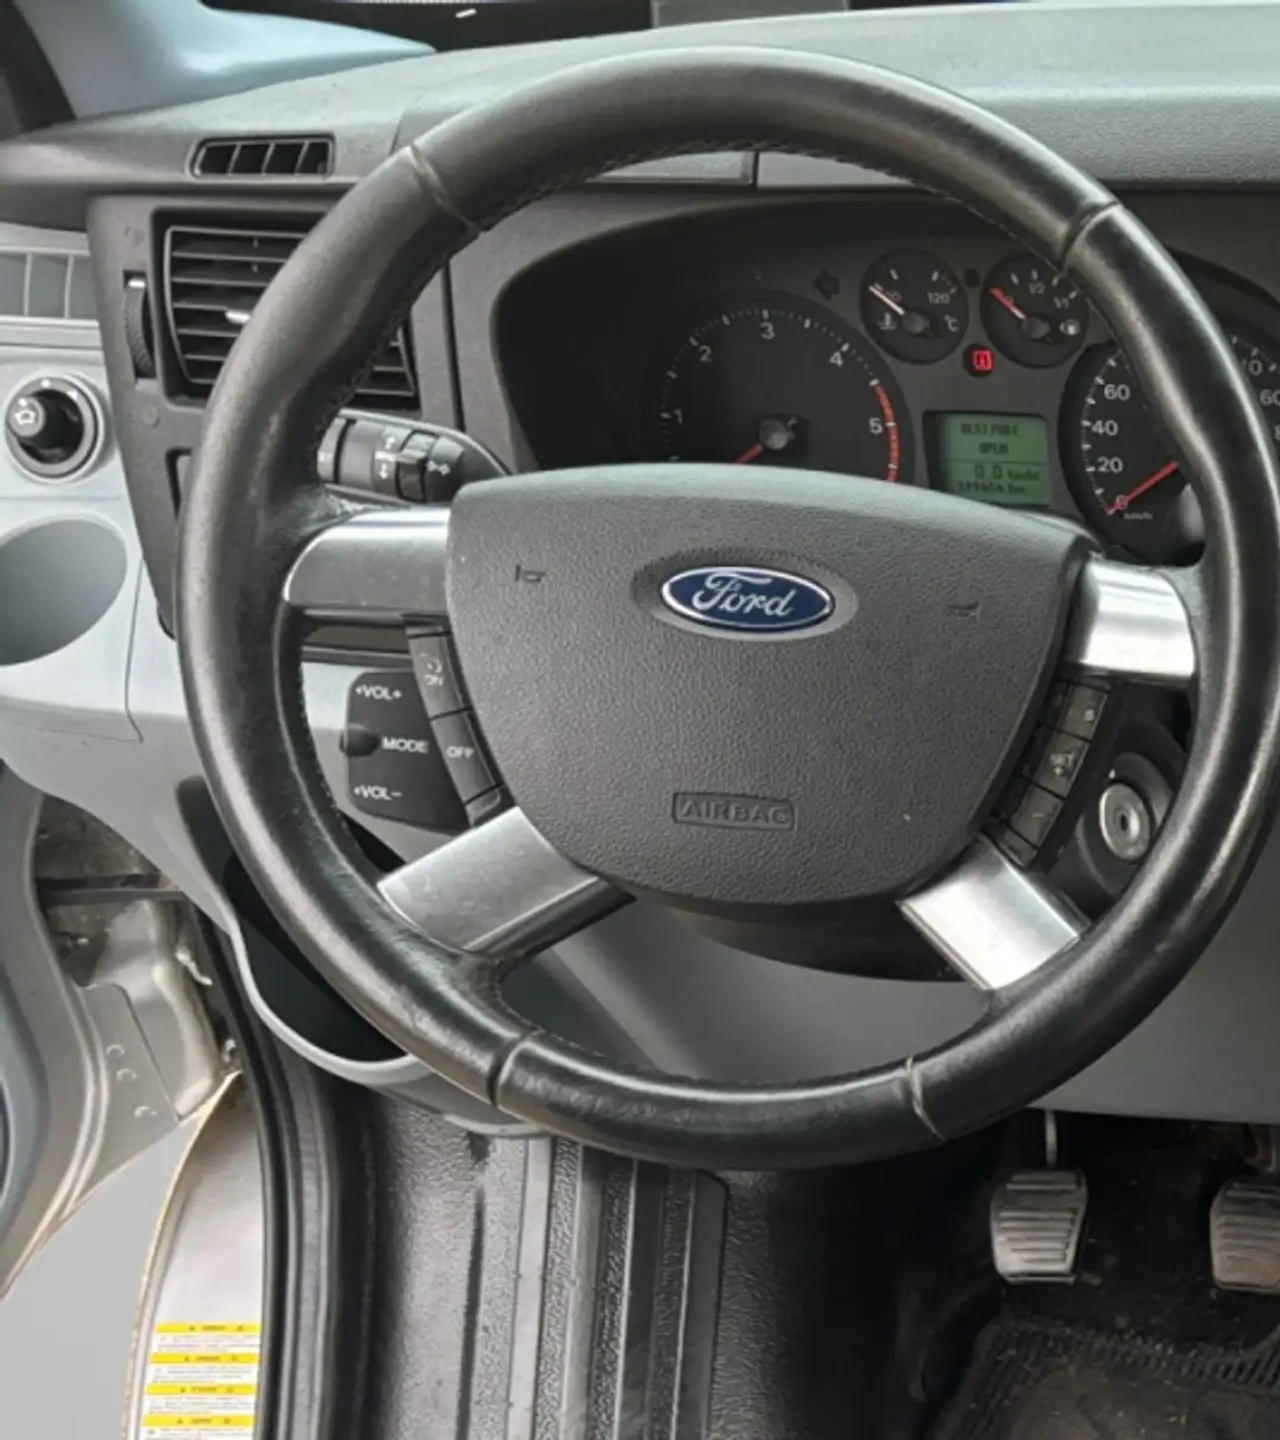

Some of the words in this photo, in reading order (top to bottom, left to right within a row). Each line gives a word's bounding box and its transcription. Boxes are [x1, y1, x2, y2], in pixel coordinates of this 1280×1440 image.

[927, 293, 950, 304] 120
[760, 322, 775, 339] 3
[699, 345, 713, 362] 2
[829, 351, 844, 367] 4
[1103, 384, 1131, 401] 60
[673, 408, 684, 424] 1
[868, 417, 883, 435] 5
[1092, 420, 1119, 437] 40
[1097, 456, 1124, 474] 20
[692, 572, 797, 617] Ford
[381, 736, 430, 754] MODE
[447, 745, 474, 759] OFF
[681, 801, 789, 825] AIRBAG
